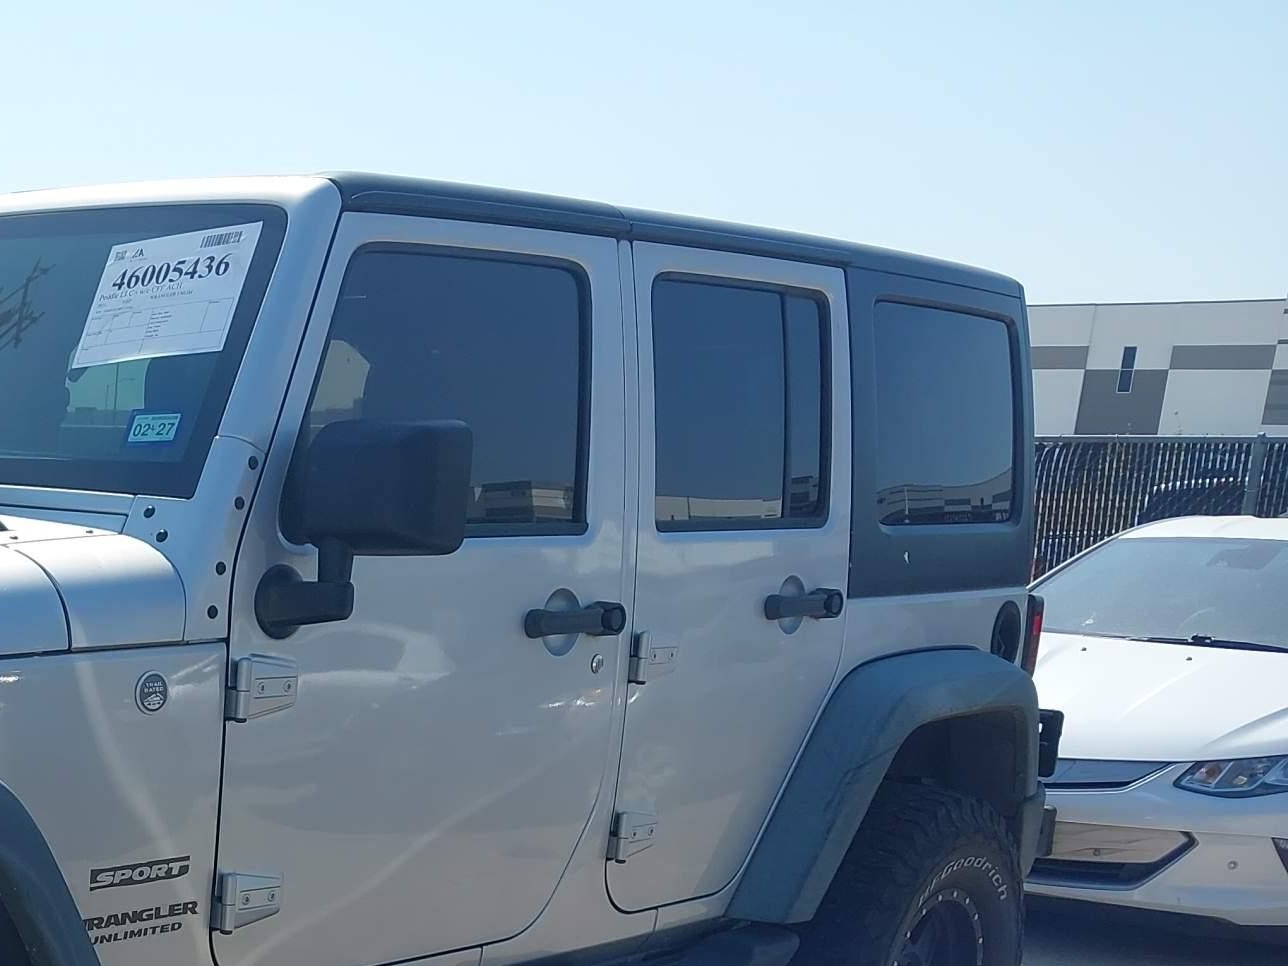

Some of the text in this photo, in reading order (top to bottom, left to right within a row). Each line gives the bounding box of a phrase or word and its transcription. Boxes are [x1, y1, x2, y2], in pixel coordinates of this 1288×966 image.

[112, 252, 233, 291] 46005436
[90, 860, 190, 888] SPORT
[83, 900, 199, 931] RANGLER
[89, 921, 183, 945] UNLIMITED
